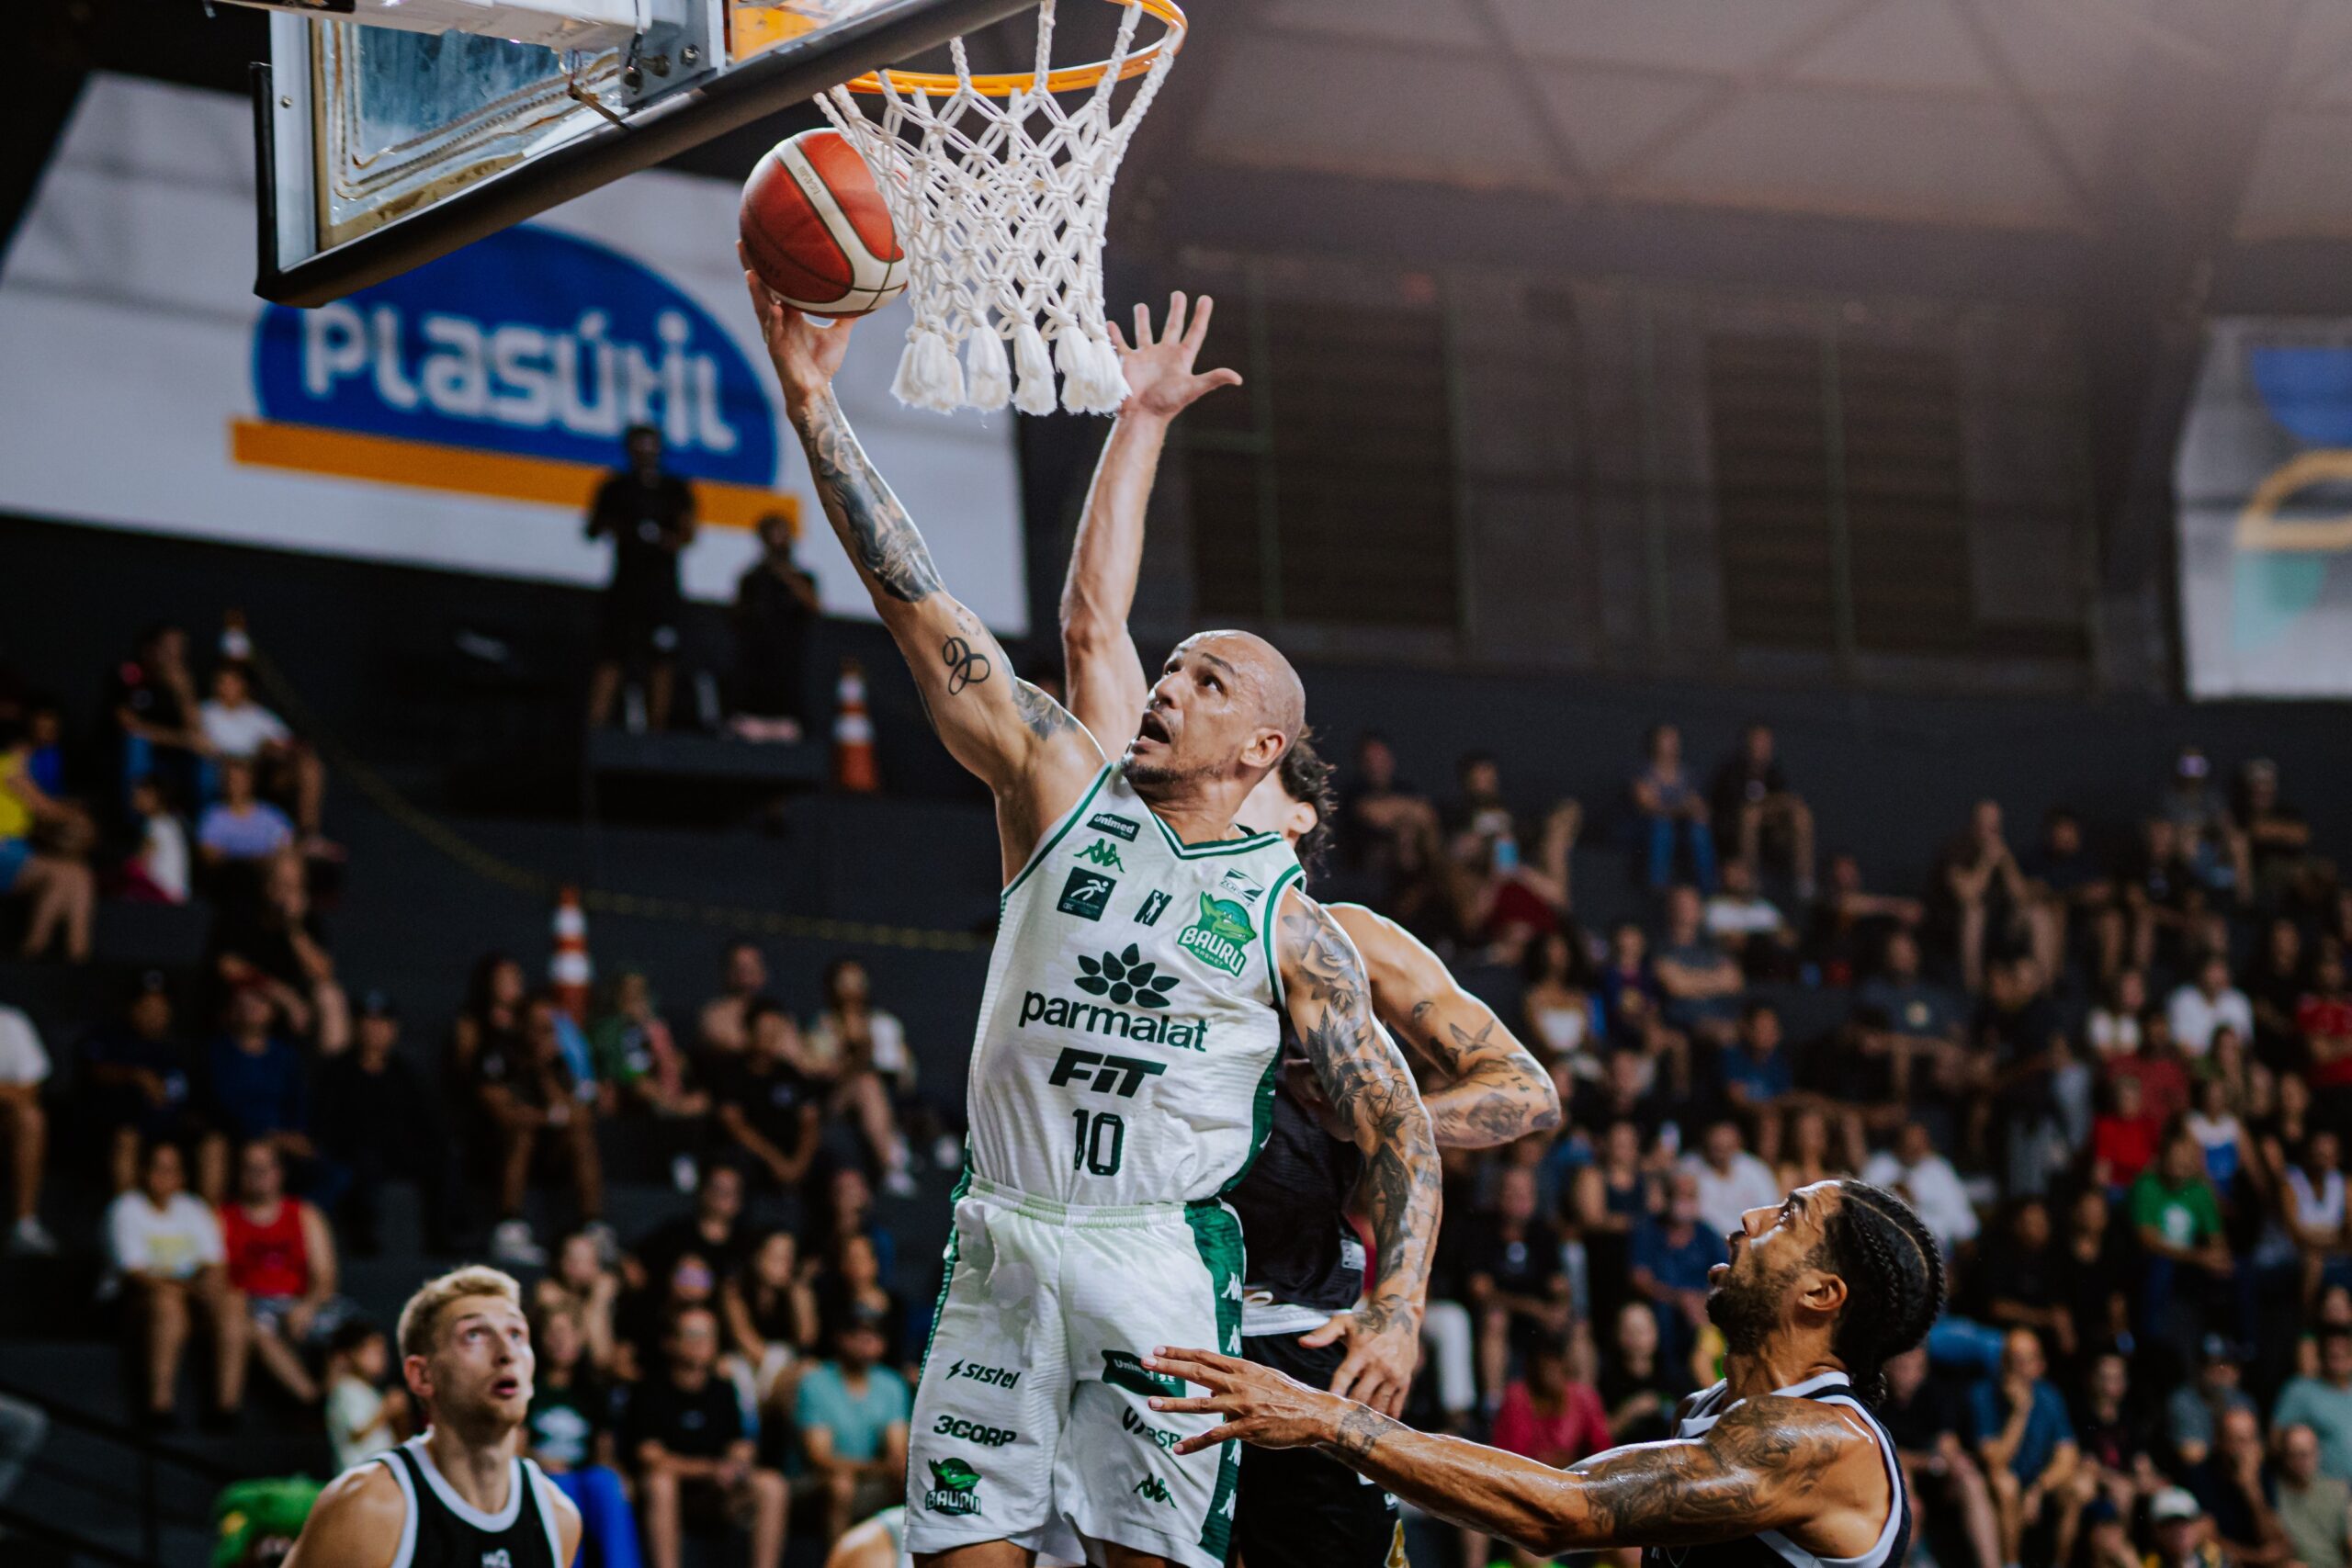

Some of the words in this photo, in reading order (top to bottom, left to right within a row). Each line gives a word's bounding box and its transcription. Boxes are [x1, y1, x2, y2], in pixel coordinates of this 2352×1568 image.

[1181, 927, 1244, 976] BAURU
[1018, 990, 1208, 1053] parmalat
[1072, 1108, 1125, 1177] 10
[933, 1415, 1017, 1448] 3CORP
[927, 1489, 980, 1515] BAURU
